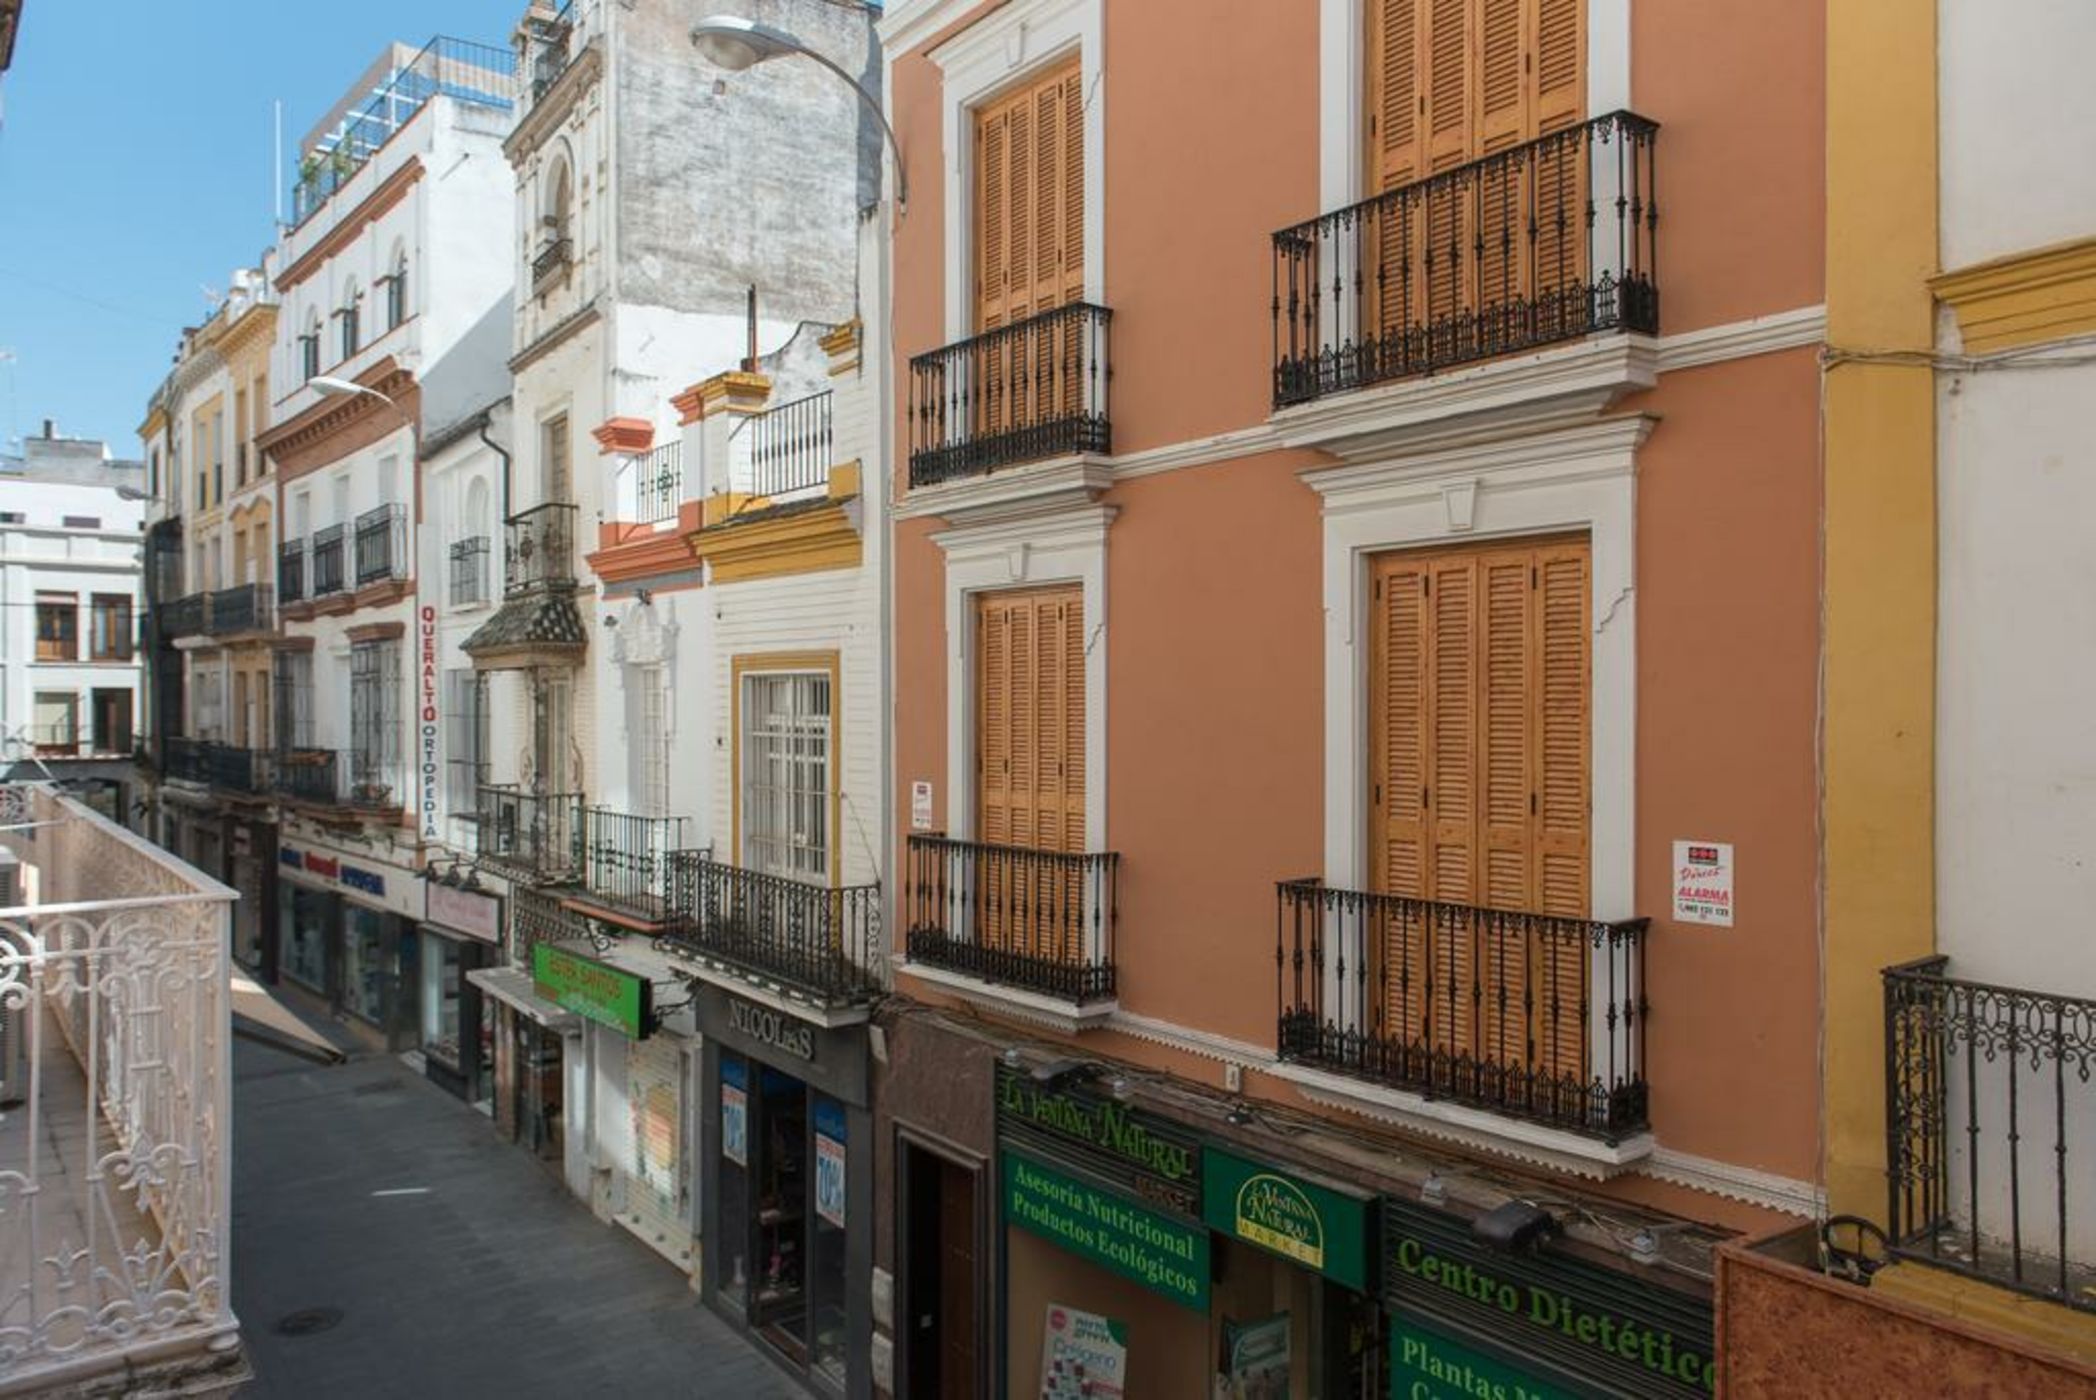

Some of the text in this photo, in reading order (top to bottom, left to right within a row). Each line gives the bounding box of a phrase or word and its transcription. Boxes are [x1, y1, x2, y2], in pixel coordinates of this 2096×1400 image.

[422, 606, 437, 837] QUERALTO ORTOPEDIA
[1679, 887, 1729, 902] ALARMA
[1013, 1191, 1197, 1297] Productos Ecológicos
[1014, 1163, 1195, 1261] Asesoría Nutricional
[1399, 1238, 1520, 1314] Centro
[1402, 1337, 1507, 1400] Plantas
